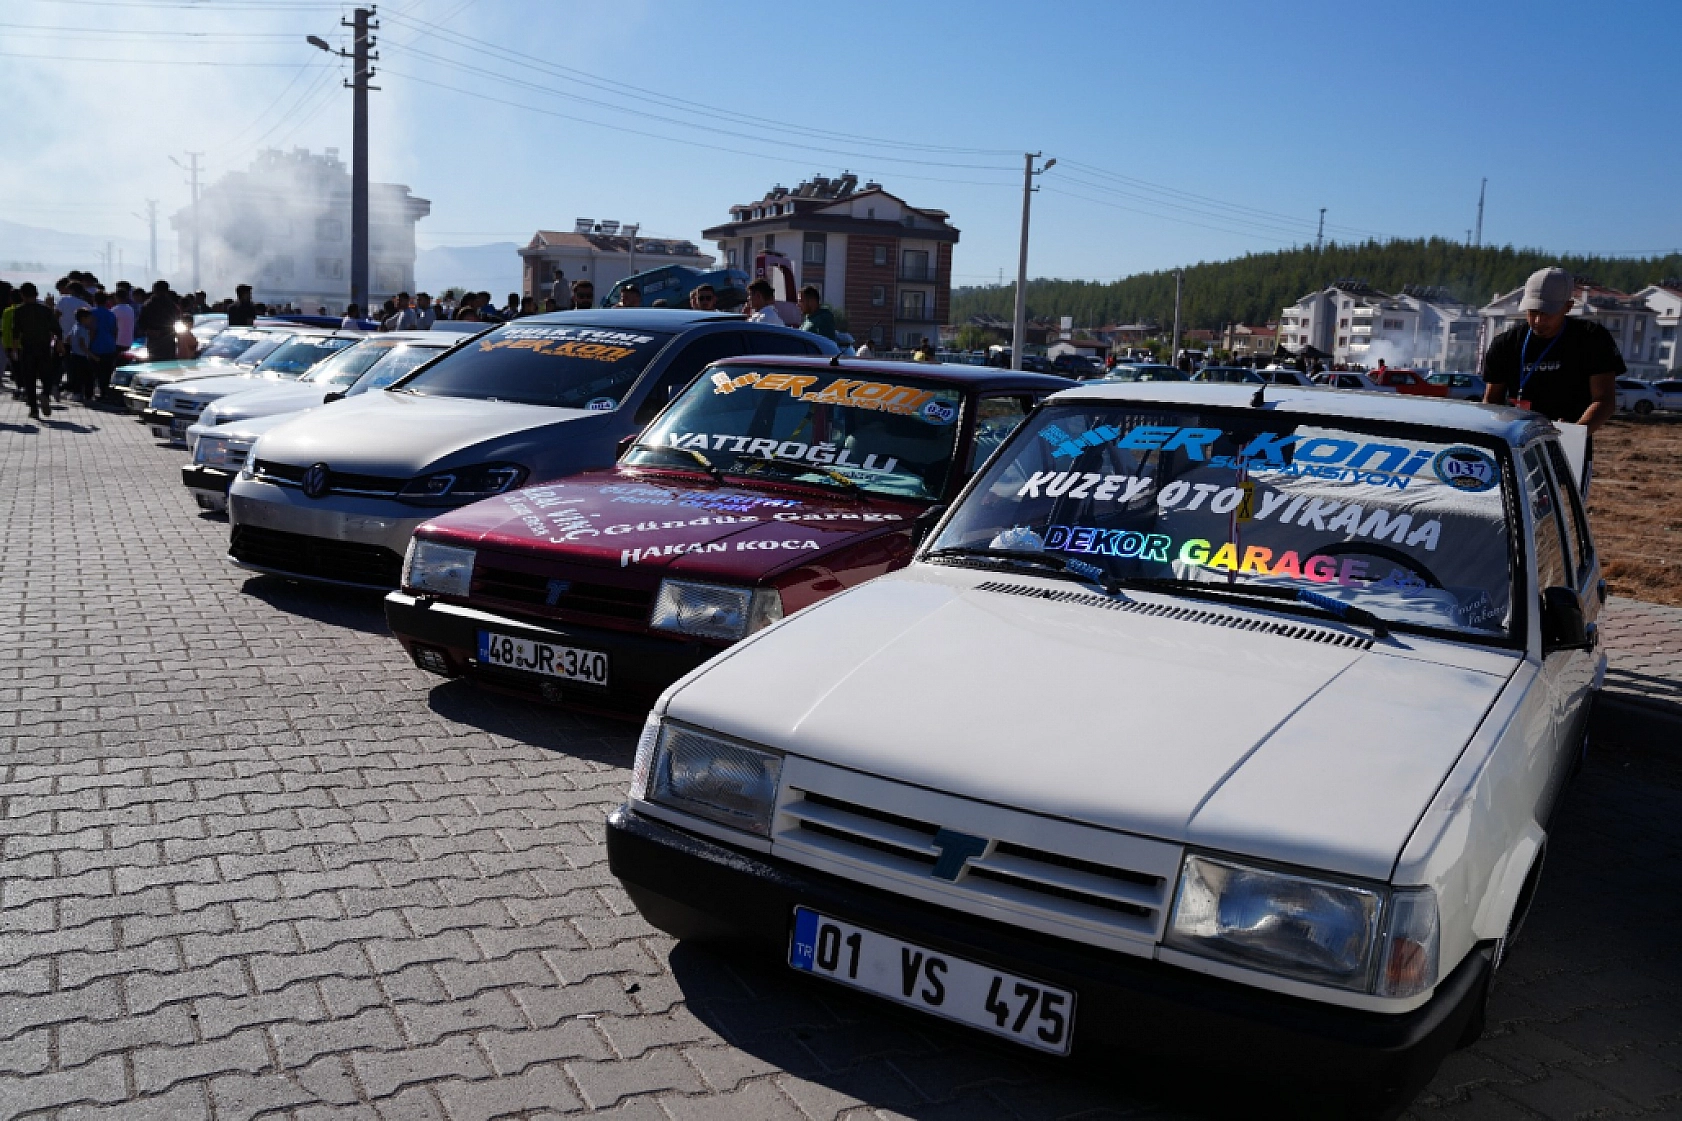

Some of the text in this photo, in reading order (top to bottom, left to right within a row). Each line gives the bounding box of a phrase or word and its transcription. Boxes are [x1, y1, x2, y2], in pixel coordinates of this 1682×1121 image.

[669, 432, 899, 475] YATIROĞLU
[1447, 461, 1487, 478] 037
[1017, 471, 1443, 551] KUZEY OTO YIKAMA
[620, 540, 820, 568] HAKAN KOCA
[1044, 525, 1371, 588] DEKOR GARAGE
[490, 635, 606, 682] 48 JR 340
[796, 942, 812, 959] TR
[817, 922, 1066, 1044] 01 VS 475
